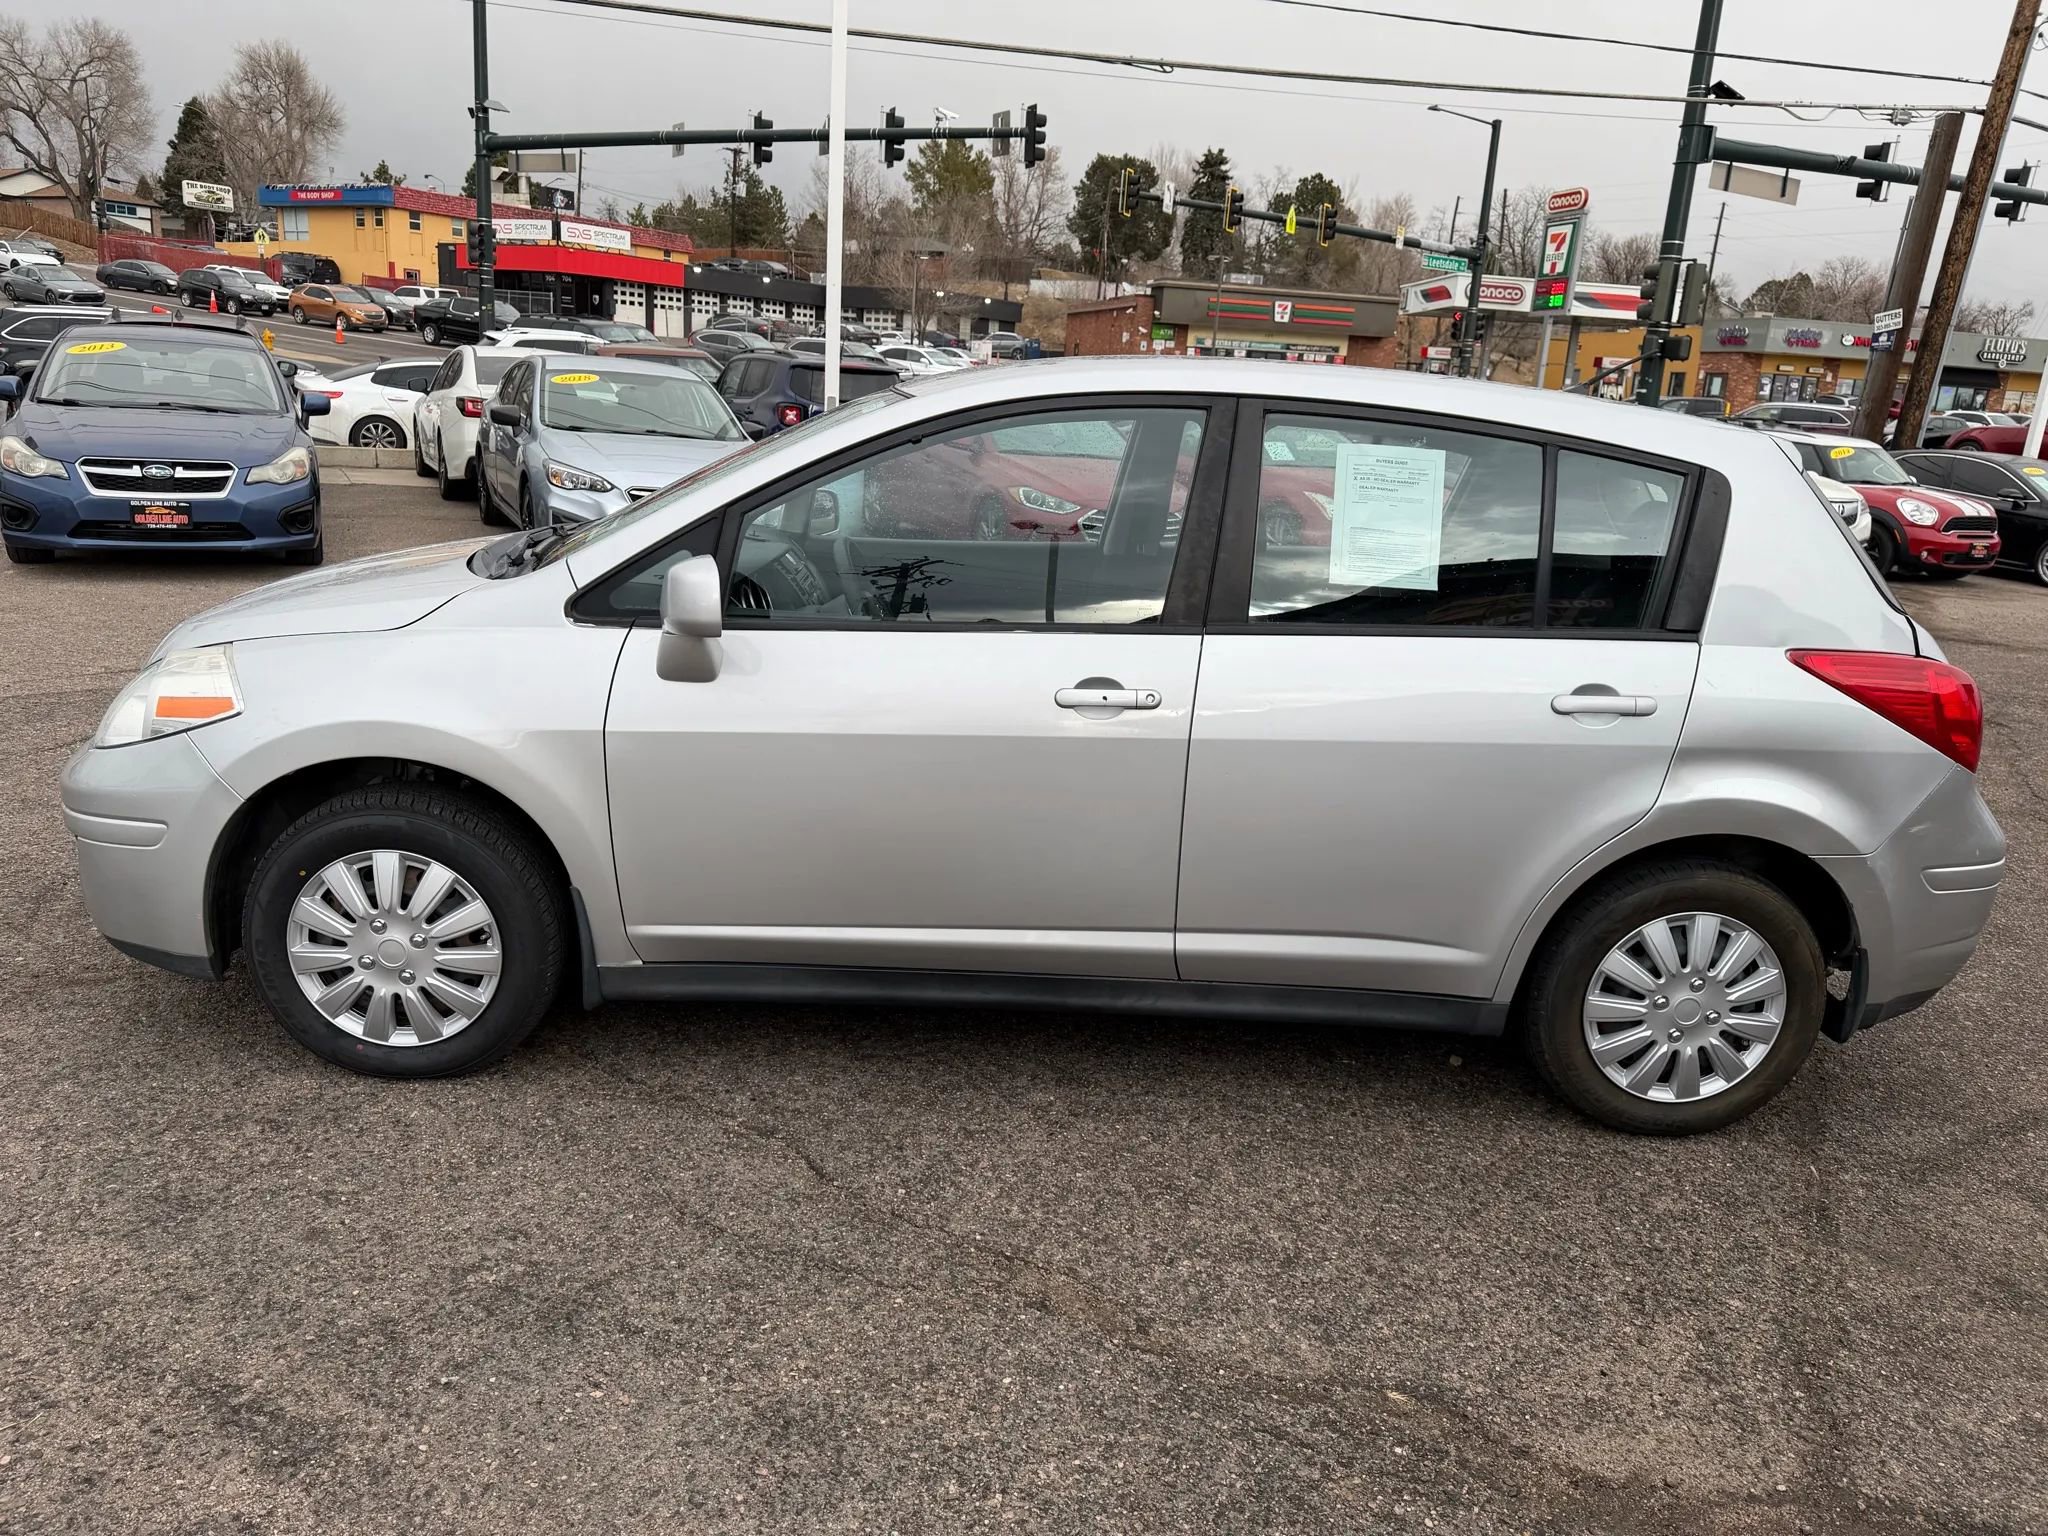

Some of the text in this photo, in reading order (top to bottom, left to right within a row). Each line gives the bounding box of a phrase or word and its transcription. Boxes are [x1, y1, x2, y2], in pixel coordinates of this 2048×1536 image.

[514, 223, 547, 231] SPECTRUM
[593, 231, 626, 241] SPECTRUM
[1429, 257, 1459, 270] Leetsdale
[1875, 311, 1902, 324] GUTTERS
[1160, 328, 1174, 336] ATM
[78, 343, 116, 353] 2013
[1984, 338, 2027, 354] FLOYD'S
[1983, 352, 2024, 361] BARBERSHOP
[135, 514, 189, 525] GOLDEN LINE AUTO
